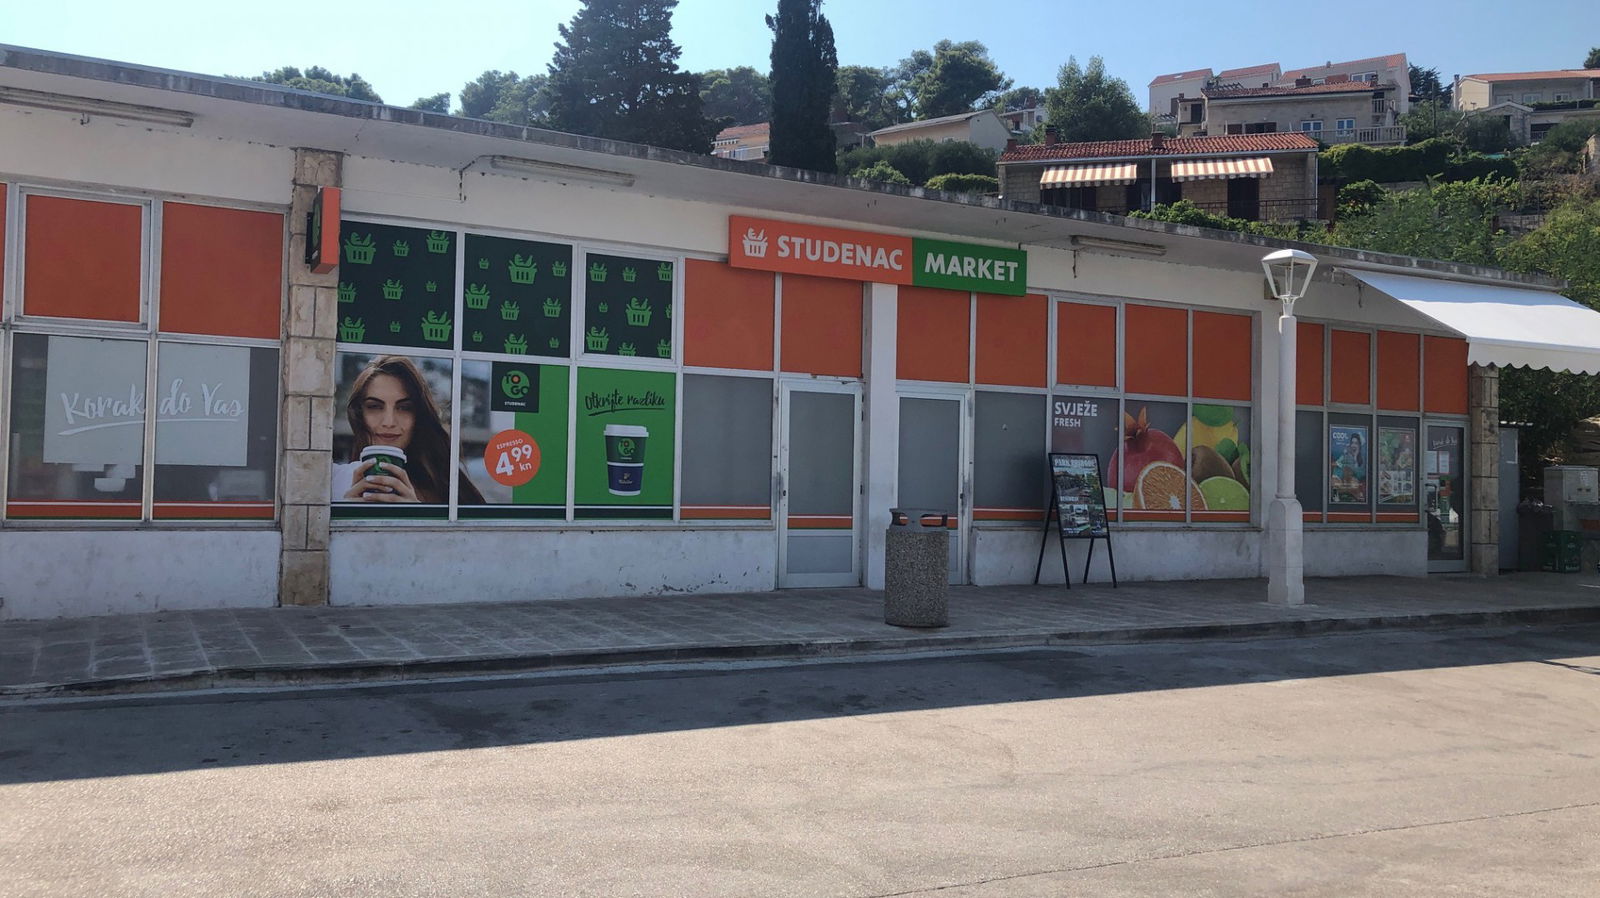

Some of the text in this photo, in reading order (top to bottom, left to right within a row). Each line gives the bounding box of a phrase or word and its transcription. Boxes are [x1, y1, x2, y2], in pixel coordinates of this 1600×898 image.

[777, 235, 1019, 282] STUDENAC MARKET
[504, 373, 521, 385] TO
[511, 385, 529, 396] GO
[61, 378, 245, 424] Korak do Vas
[585, 388, 665, 413] Otkrijte razliku
[1054, 400, 1098, 417] SVJEŽE
[1054, 417, 1081, 427] FRESH
[1332, 431, 1349, 440] COOL
[496, 438, 523, 450] ESPRESSO
[519, 462, 532, 472] kn
